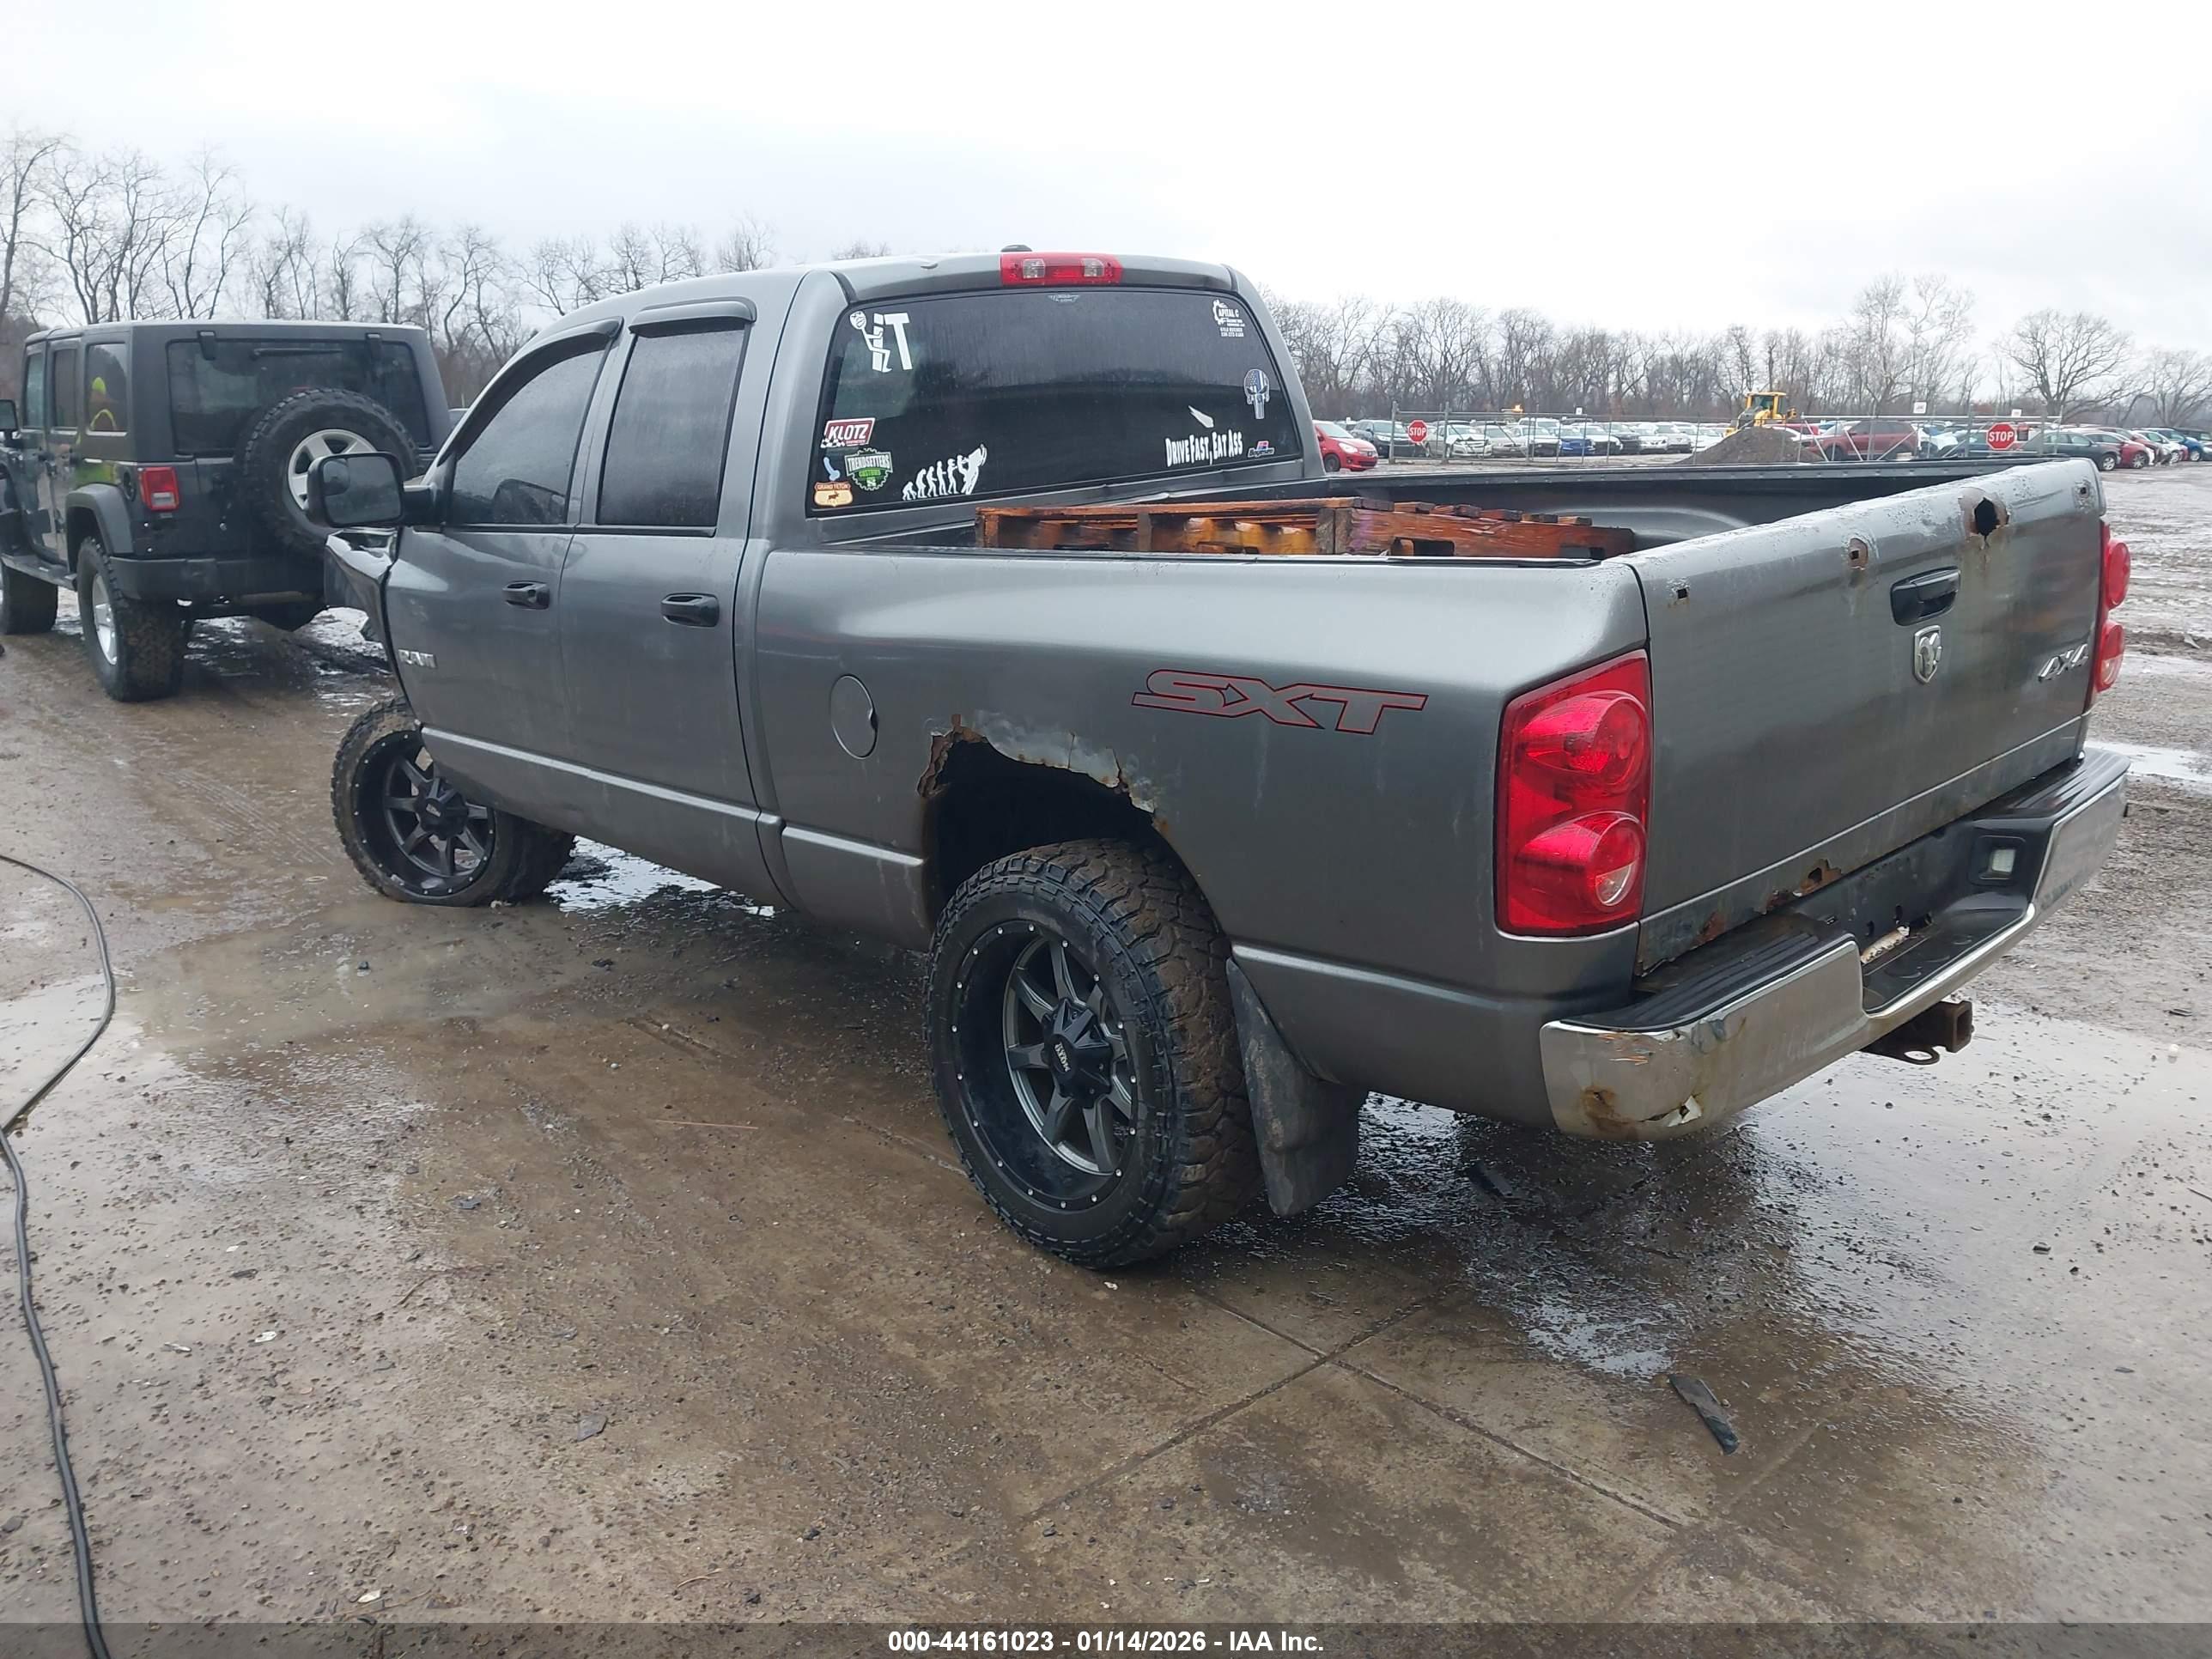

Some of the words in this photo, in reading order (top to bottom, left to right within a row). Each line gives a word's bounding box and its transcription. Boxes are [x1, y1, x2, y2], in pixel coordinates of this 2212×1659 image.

[829, 423, 869, 441] KLOTZ
[1409, 427, 1426, 436] STOP
[1988, 431, 2014, 441] STOP
[847, 454, 890, 471] TRENDSETTERS
[398, 648, 435, 668] RAM
[1132, 670, 1429, 735] SXT
